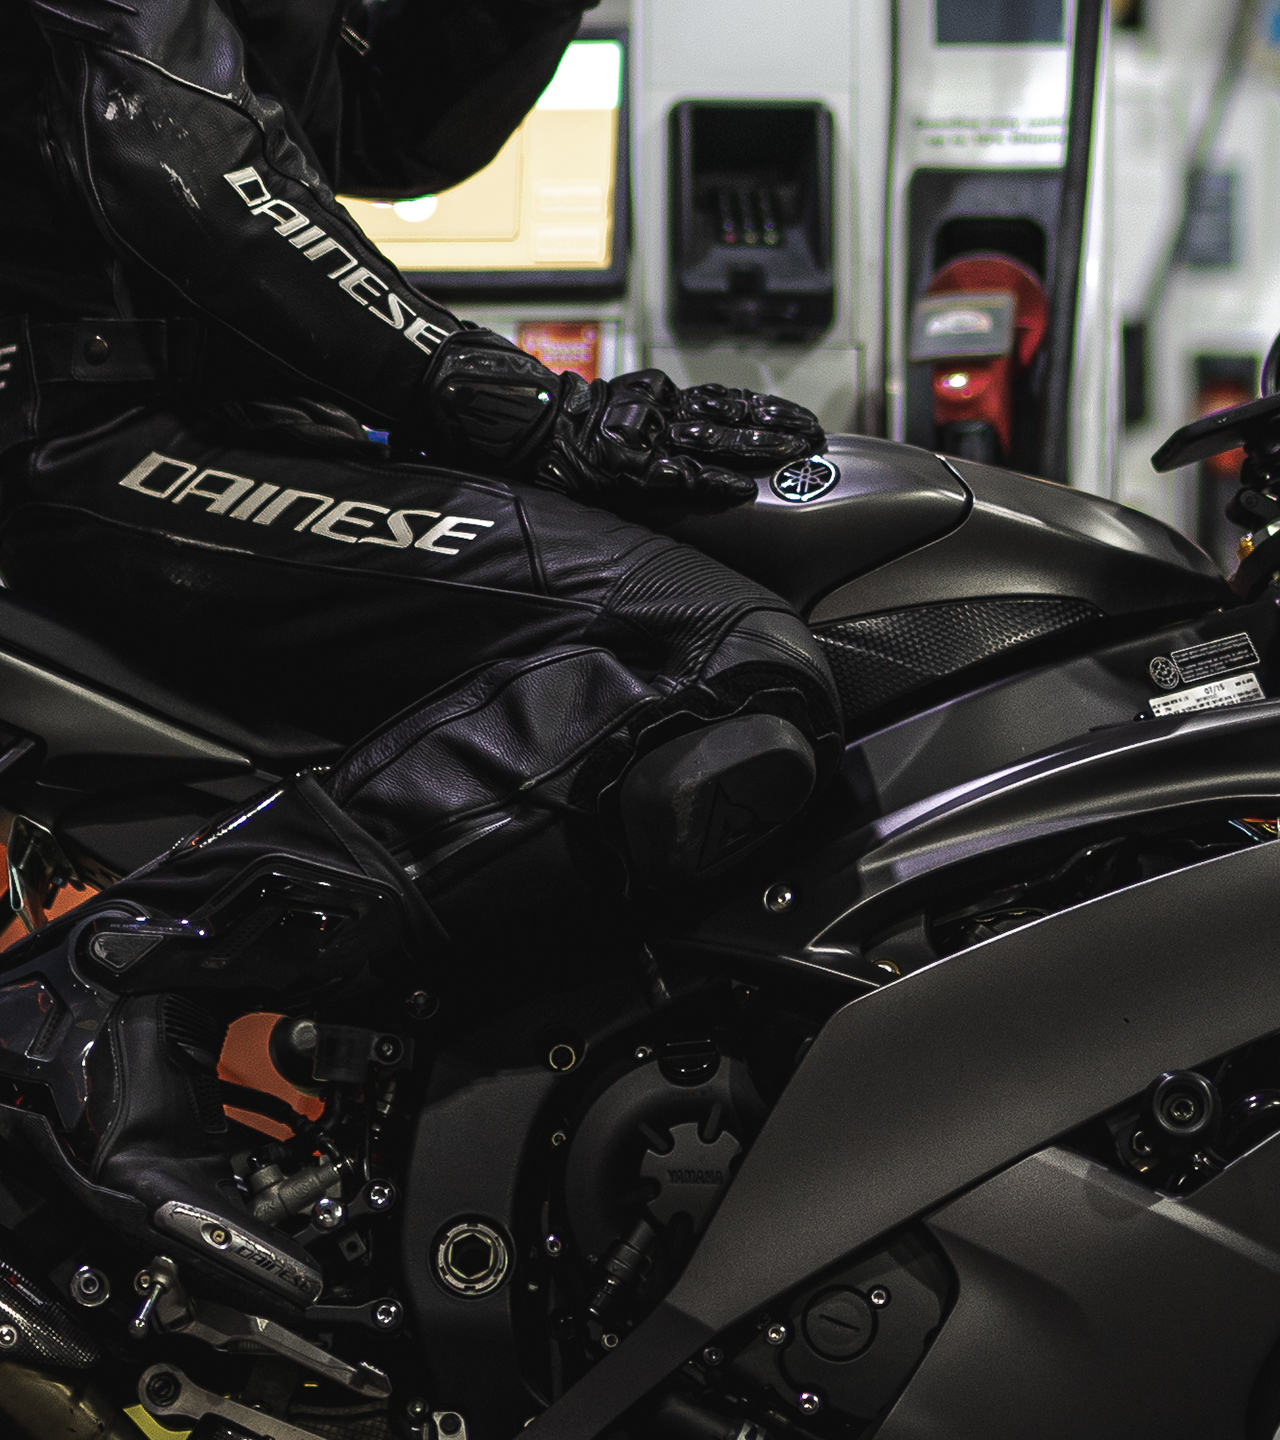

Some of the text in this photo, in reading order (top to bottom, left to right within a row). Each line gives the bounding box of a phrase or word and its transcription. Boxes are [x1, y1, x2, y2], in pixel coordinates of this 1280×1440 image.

[222, 166, 451, 356] DAINESE
[119, 450, 495, 557] DAINESE
[667, 1169, 724, 1185] YAMAHA
